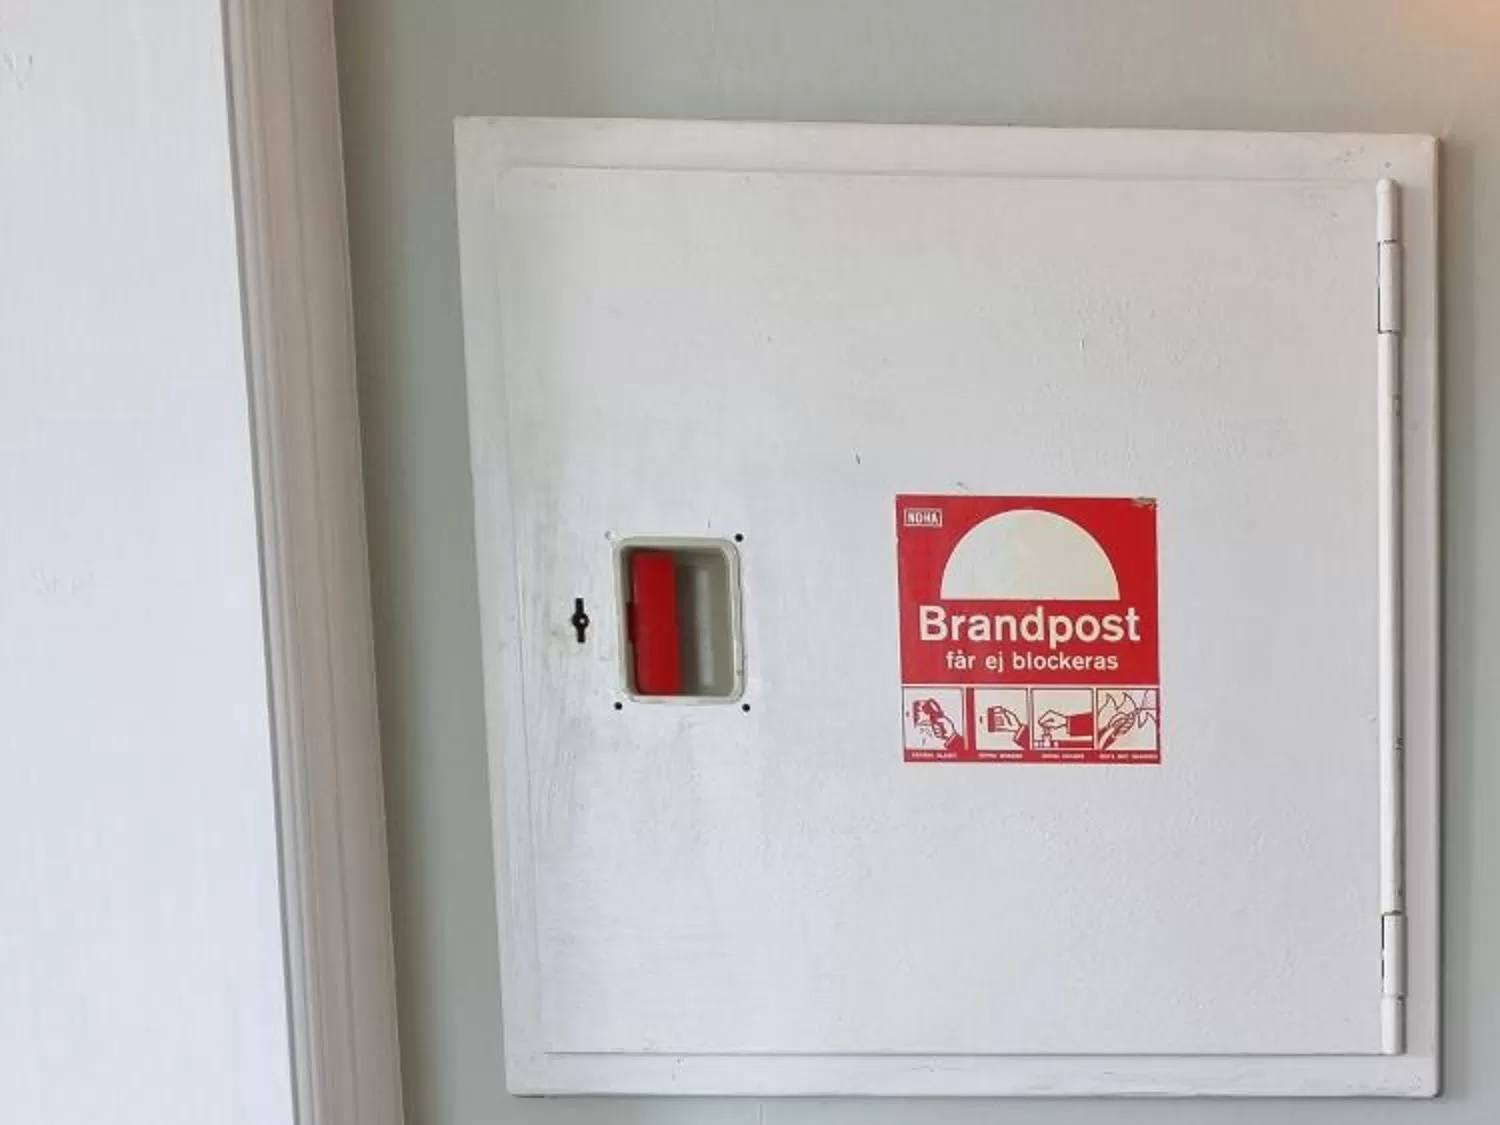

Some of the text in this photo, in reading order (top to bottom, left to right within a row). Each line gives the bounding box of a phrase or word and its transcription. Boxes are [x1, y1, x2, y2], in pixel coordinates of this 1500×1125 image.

[918, 604, 1141, 650] Brandpost
[945, 649, 1119, 672] får ej blockeras
